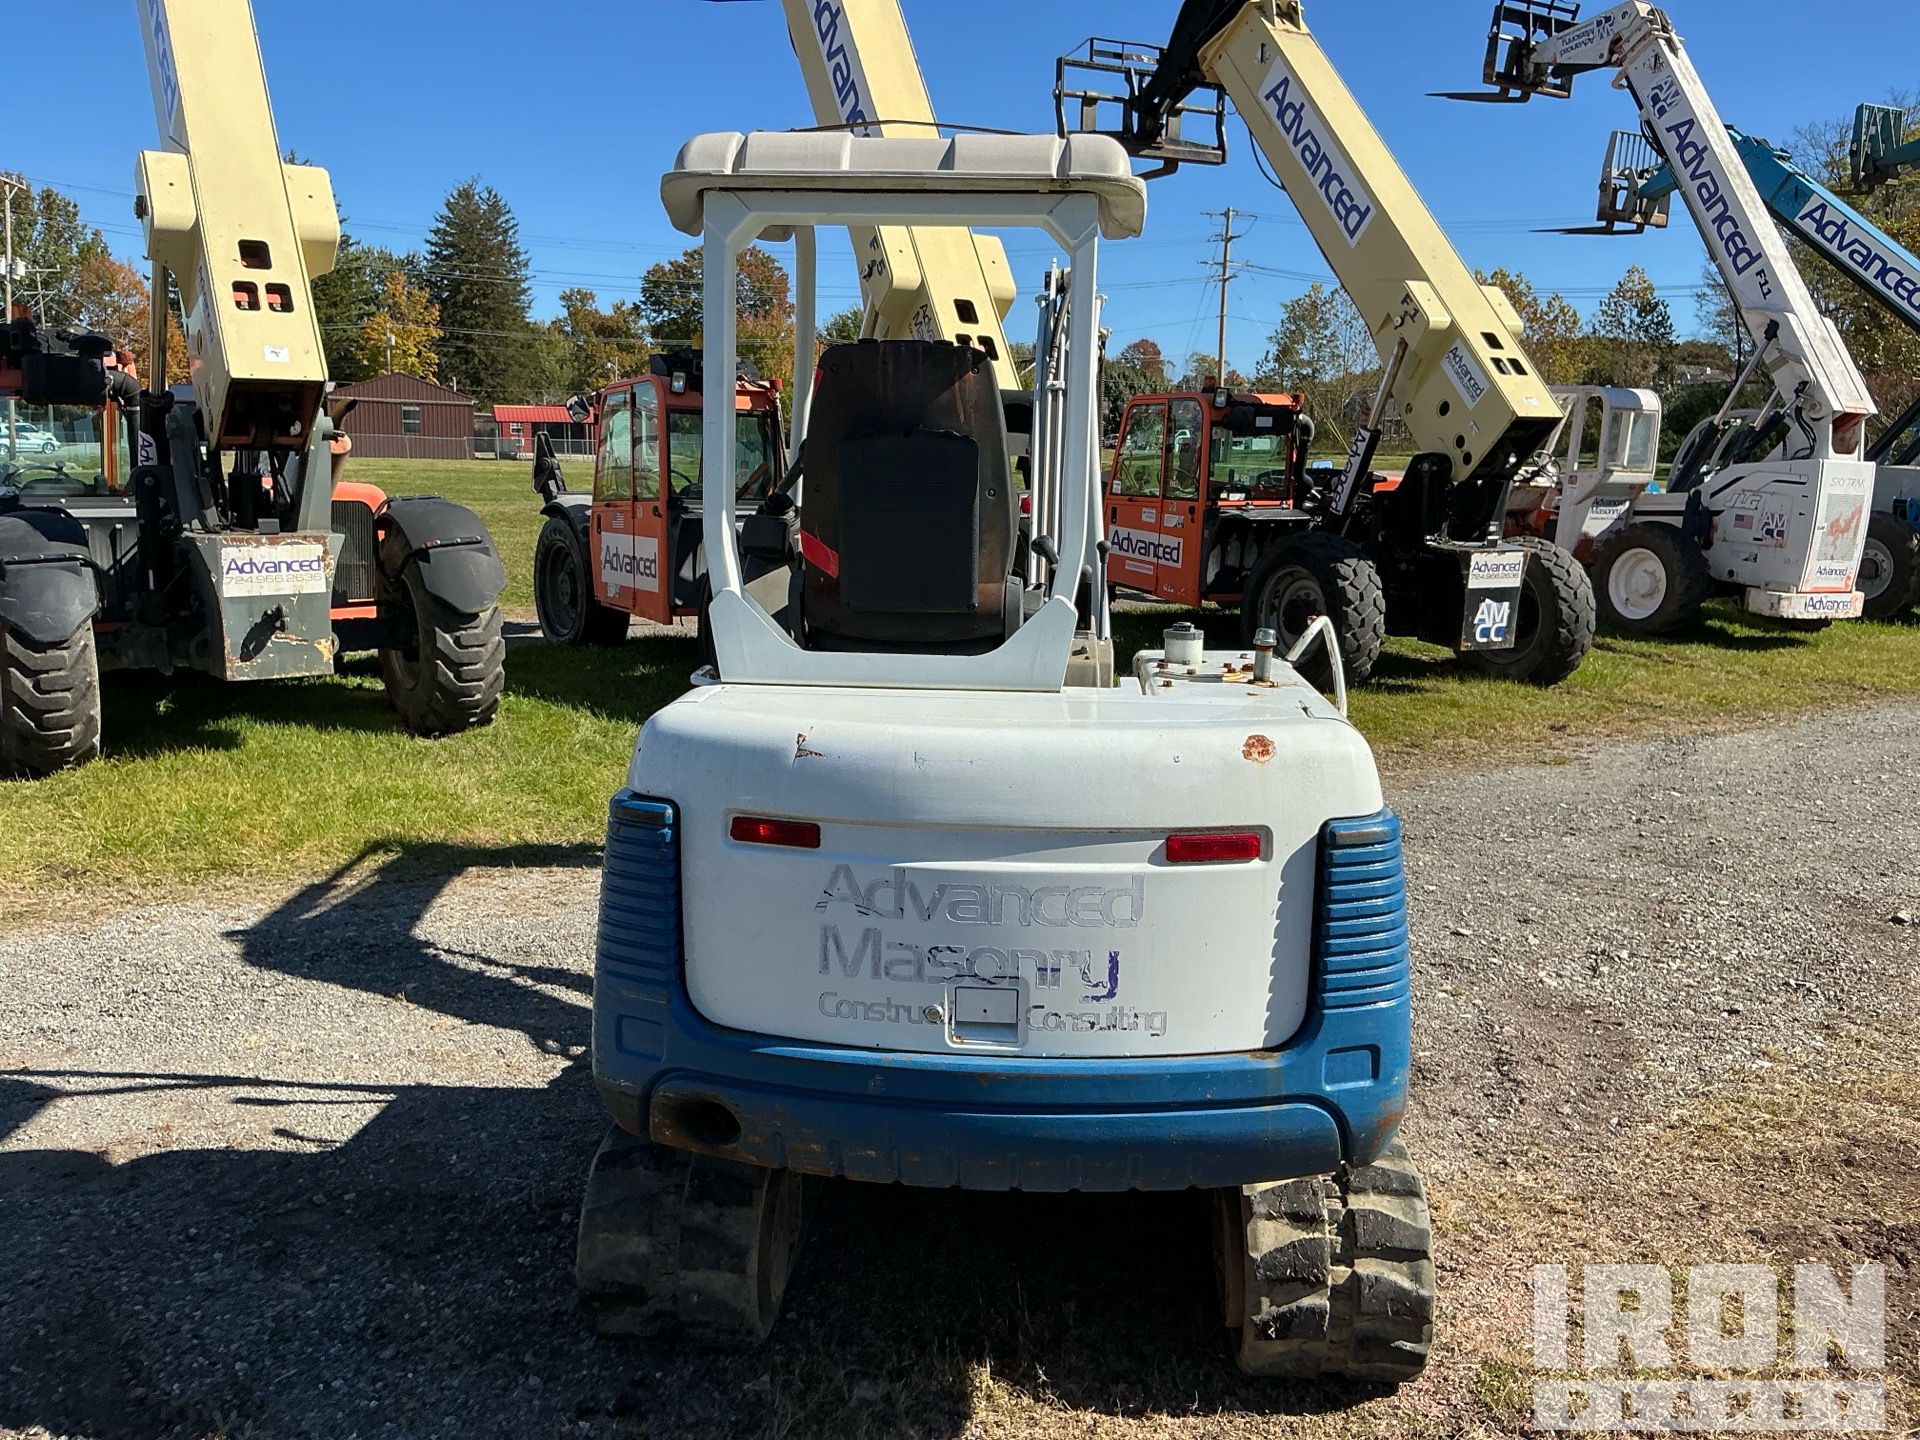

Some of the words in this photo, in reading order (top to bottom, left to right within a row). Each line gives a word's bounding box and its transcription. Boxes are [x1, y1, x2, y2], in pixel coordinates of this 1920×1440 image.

[1560, 35, 1595, 58] Advanced
[1264, 76, 1371, 239] Advanced
[1665, 117, 1763, 277] Advanced
[1755, 268, 1772, 300] F11
[1448, 346, 1485, 398] Advanced
[1330, 430, 1366, 511] Advanced
[1722, 492, 1763, 511] JLG
[603, 544, 657, 579] Advanced
[1111, 529, 1181, 564] Advanced
[225, 555, 321, 575] Advanced
[1472, 560, 1521, 574] Advanced
[1815, 565, 1849, 576] Advanced
[813, 863, 1146, 928] Advanced
[818, 921, 1120, 1004] Masonry
[1025, 1005, 1168, 1037] Consulting
